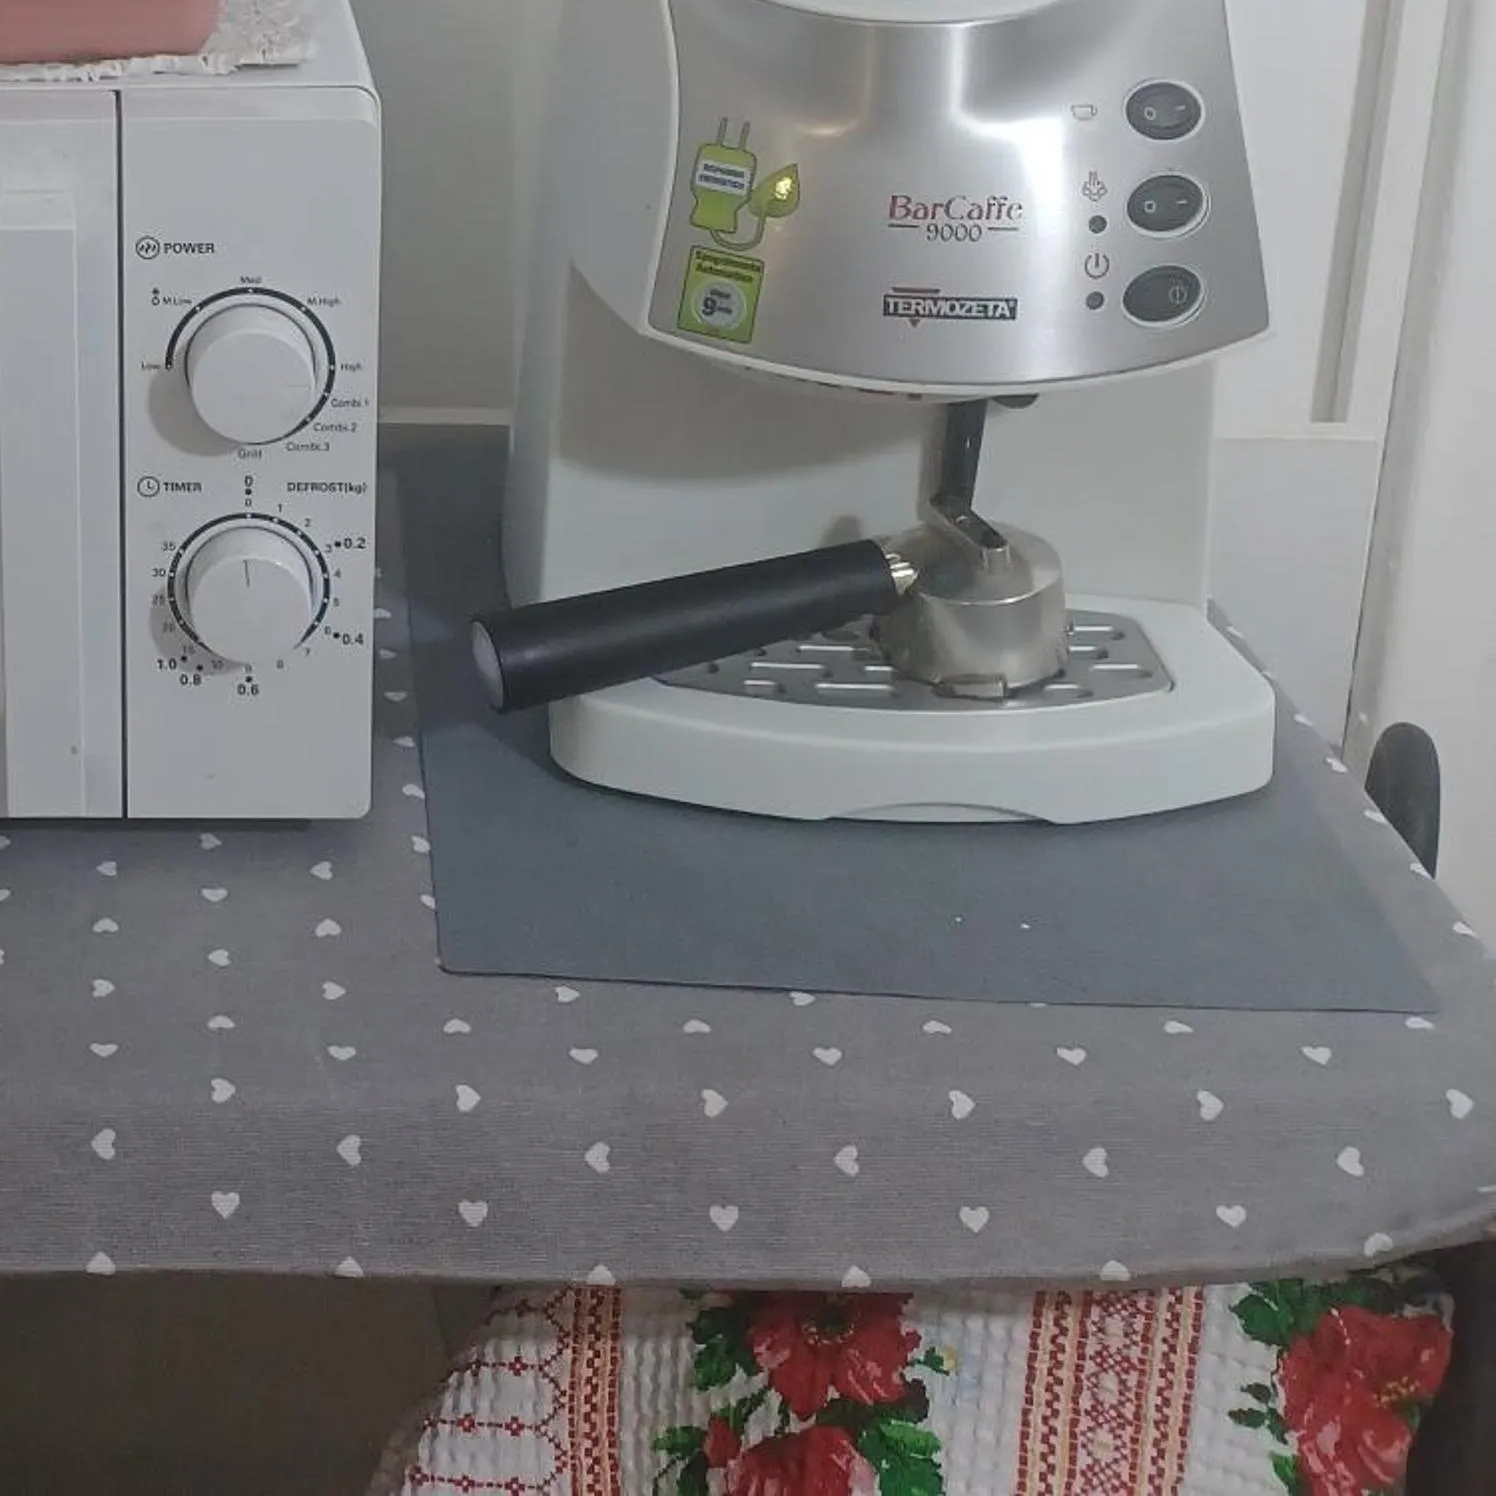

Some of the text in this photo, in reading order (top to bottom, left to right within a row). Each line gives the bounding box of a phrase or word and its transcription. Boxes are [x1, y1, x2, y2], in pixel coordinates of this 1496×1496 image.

[926, 223, 982, 242] 9000
[163, 243, 215, 253] POWER
[702, 296, 716, 315] 9
[886, 299, 1012, 317] TERMOZETA
[164, 483, 201, 492] TIMER
[287, 482, 367, 494] DEFROST(kg)
[162, 542, 175, 551] 35
[344, 538, 366, 549] 0.2
[152, 569, 166, 577] 30
[342, 633, 363, 645] 0.4
[157, 659, 177, 669] 1.0
[179, 674, 201, 685] 0.8
[237, 684, 259, 695] 0.6
